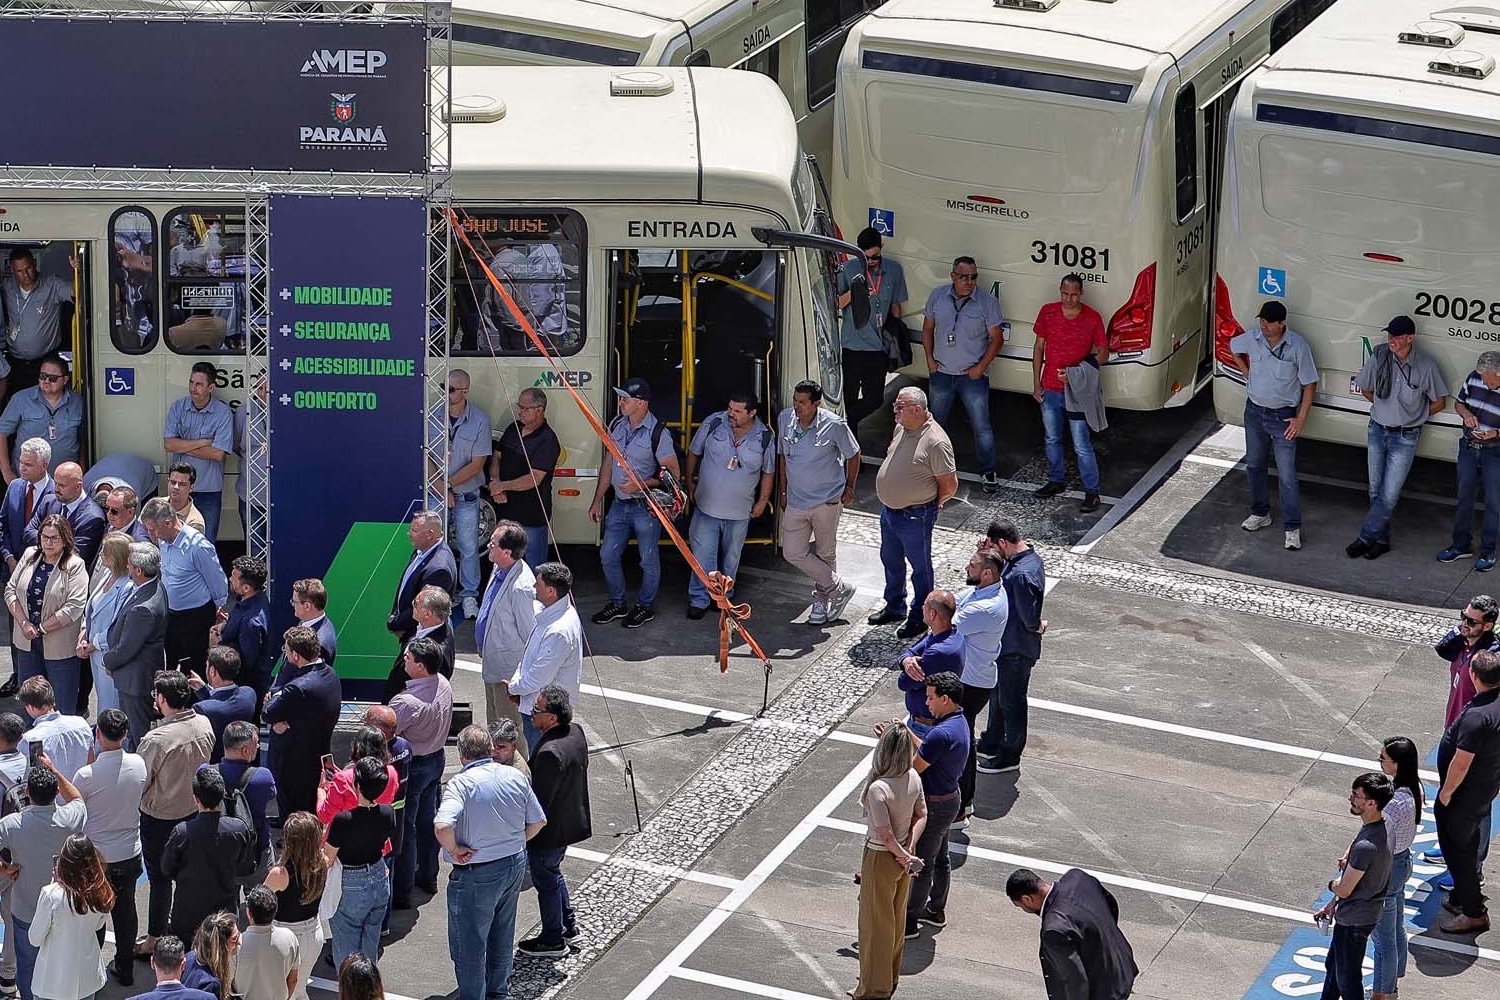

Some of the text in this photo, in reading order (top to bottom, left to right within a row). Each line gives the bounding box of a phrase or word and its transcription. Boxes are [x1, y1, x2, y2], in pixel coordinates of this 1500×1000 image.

[743, 24, 771, 54] SAÍDA
[301, 50, 387, 74] AMEP
[1221, 56, 1244, 85] SAÍDA
[300, 125, 387, 143] PARANÁ
[946, 199, 1030, 220] MASCARELLO
[627, 220, 738, 239] ENTRADA
[1177, 226, 1204, 264] 31081
[1030, 239, 1110, 273] 31081
[294, 286, 392, 306] MOBILIDADE
[294, 320, 391, 343] SEGURANÇA
[1448, 326, 1472, 340] SÃO
[294, 356, 416, 377] ACESSIBILIDADE
[533, 371, 592, 388] AMEP
[294, 391, 378, 410] CONFORTO
